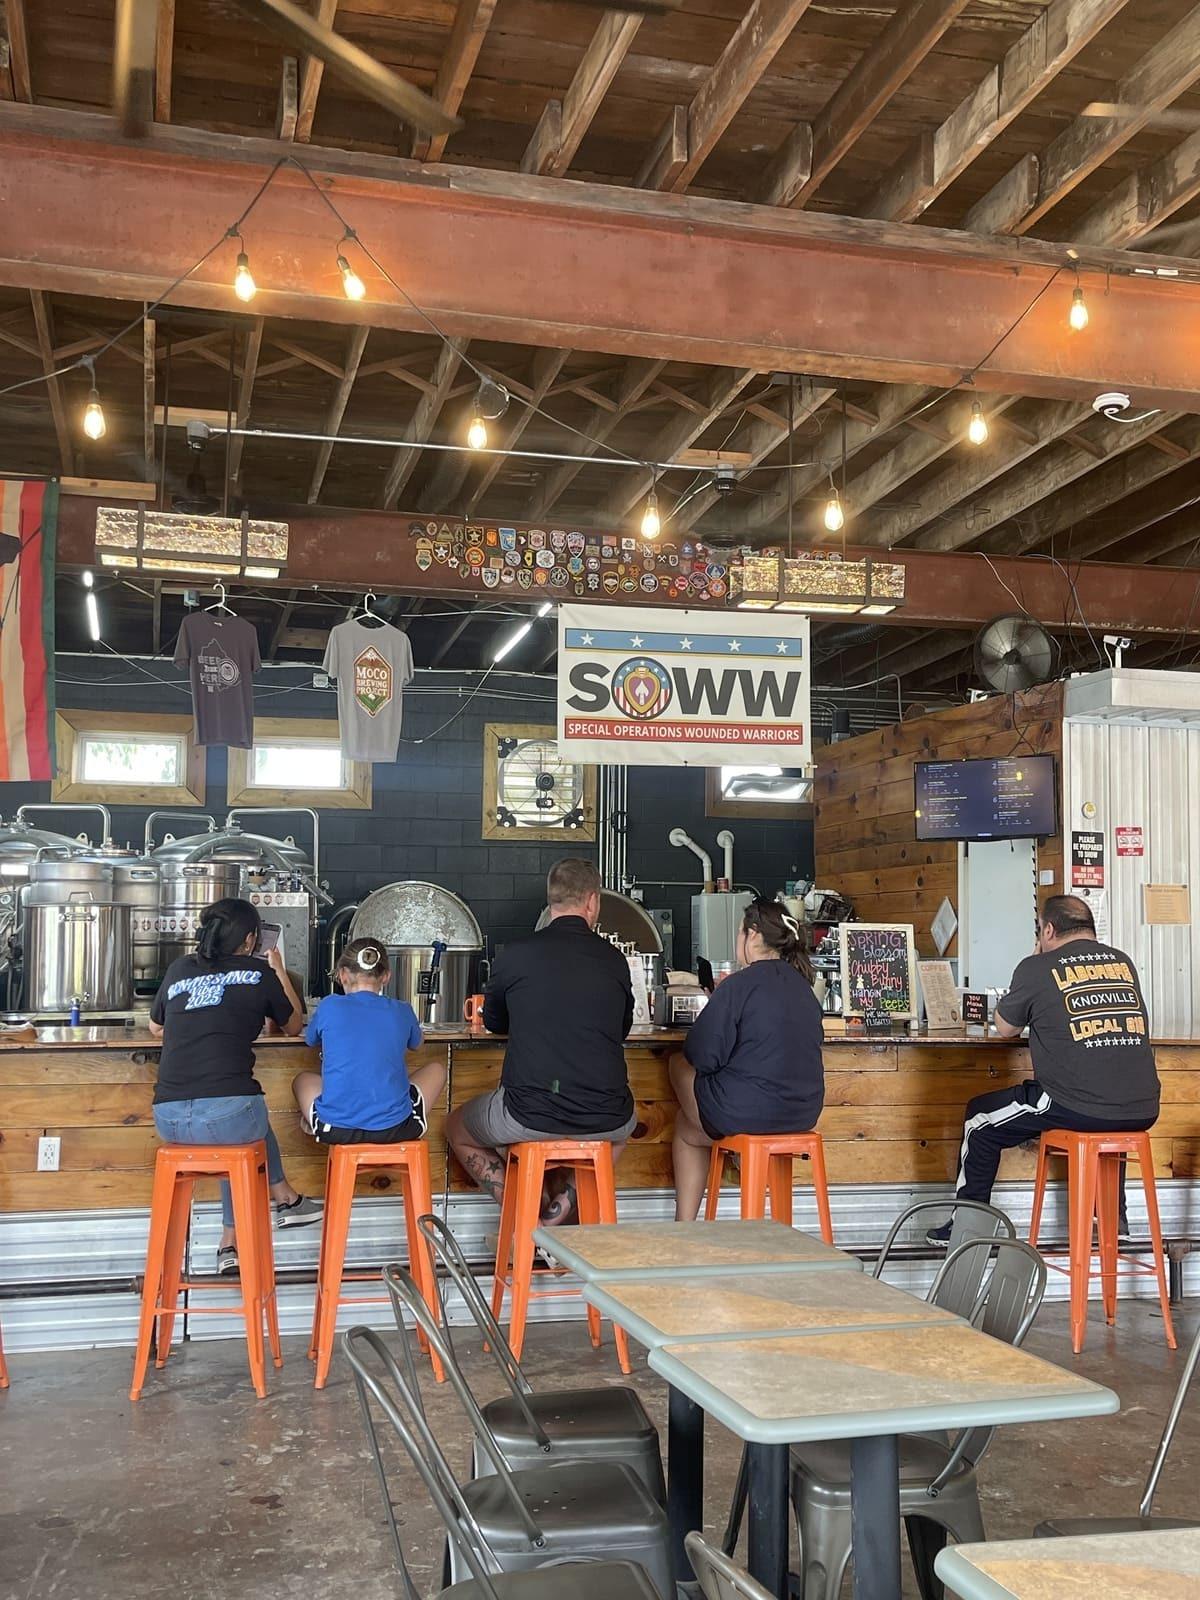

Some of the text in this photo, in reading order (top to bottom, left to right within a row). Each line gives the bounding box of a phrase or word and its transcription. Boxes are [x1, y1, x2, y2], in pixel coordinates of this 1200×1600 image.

[356, 678, 388, 688] BREWING
[356, 686, 388, 697] PROJECT
[567, 723, 800, 741] SPECIAL OPERATIONS WOUNDED WARRIORS
[1080, 843, 1103, 851] PREPARED
[851, 959, 889, 977] Chubby
[871, 973, 903, 992] Bunny
[184, 994, 222, 1011] 2025
[1071, 992, 1136, 1009] KNOXVILLE
[1069, 1018, 1122, 1042] LOCAL
